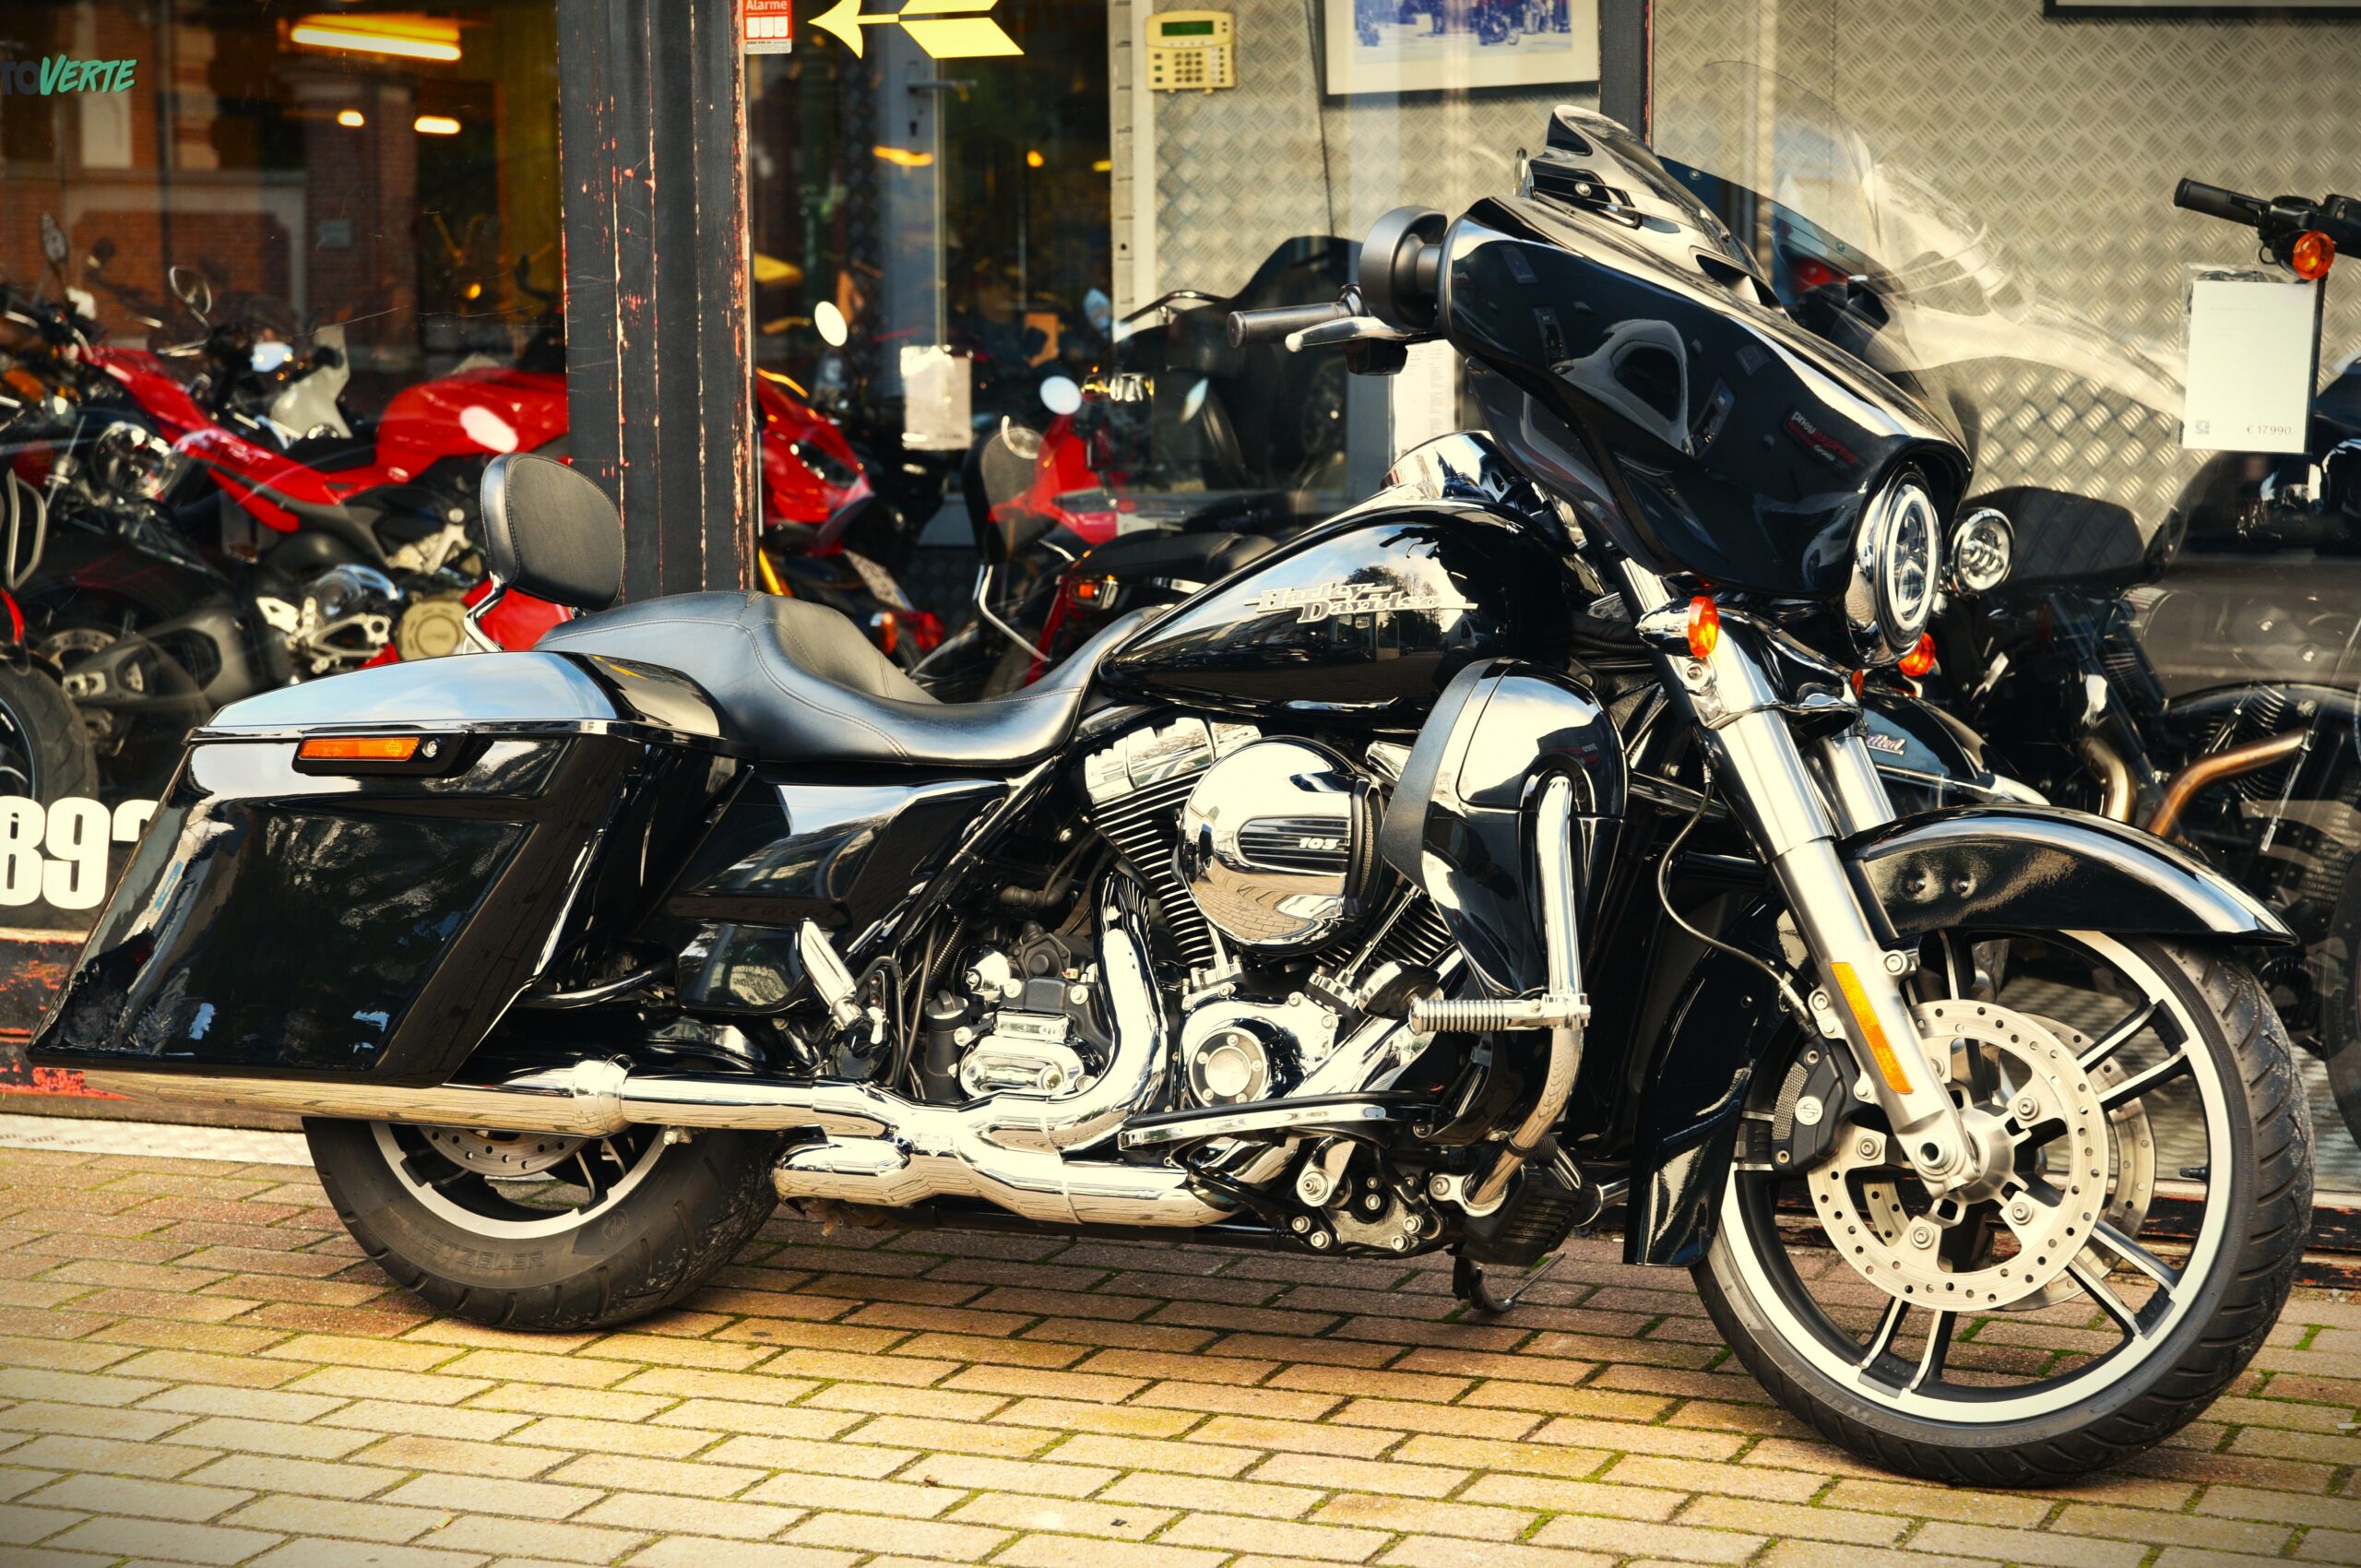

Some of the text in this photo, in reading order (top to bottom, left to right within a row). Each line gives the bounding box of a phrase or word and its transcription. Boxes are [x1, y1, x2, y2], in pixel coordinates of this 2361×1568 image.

[746, 0, 788, 10] Alarme
[1297, 591, 1471, 624] Davidso
[1299, 837, 1340, 850] 103
